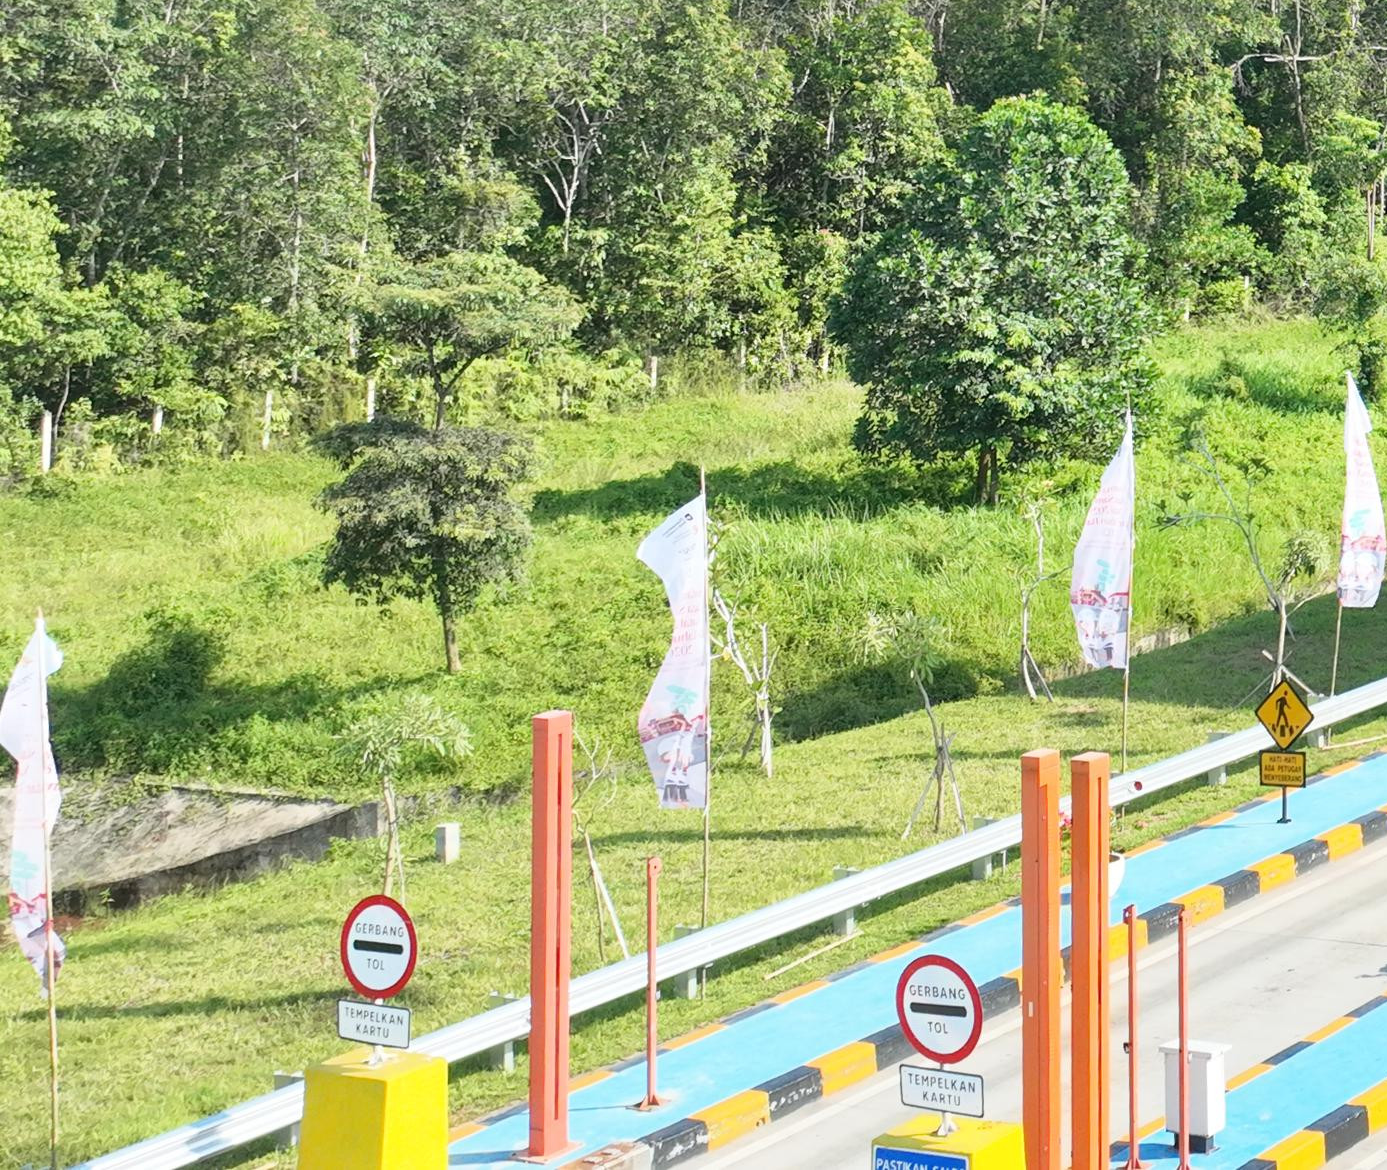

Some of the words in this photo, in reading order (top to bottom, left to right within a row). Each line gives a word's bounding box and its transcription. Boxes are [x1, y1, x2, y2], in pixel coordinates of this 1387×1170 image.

[355, 922, 404, 938] GERBANG
[367, 958, 385, 971] TOL
[909, 984, 966, 1001] GERBANG
[344, 1007, 404, 1025] TEMPELKAN
[355, 1025, 390, 1039] KARTU
[927, 1021, 949, 1035] TOL
[907, 1073, 976, 1093] TEMPELKAN
[922, 1091, 961, 1107] KARTU
